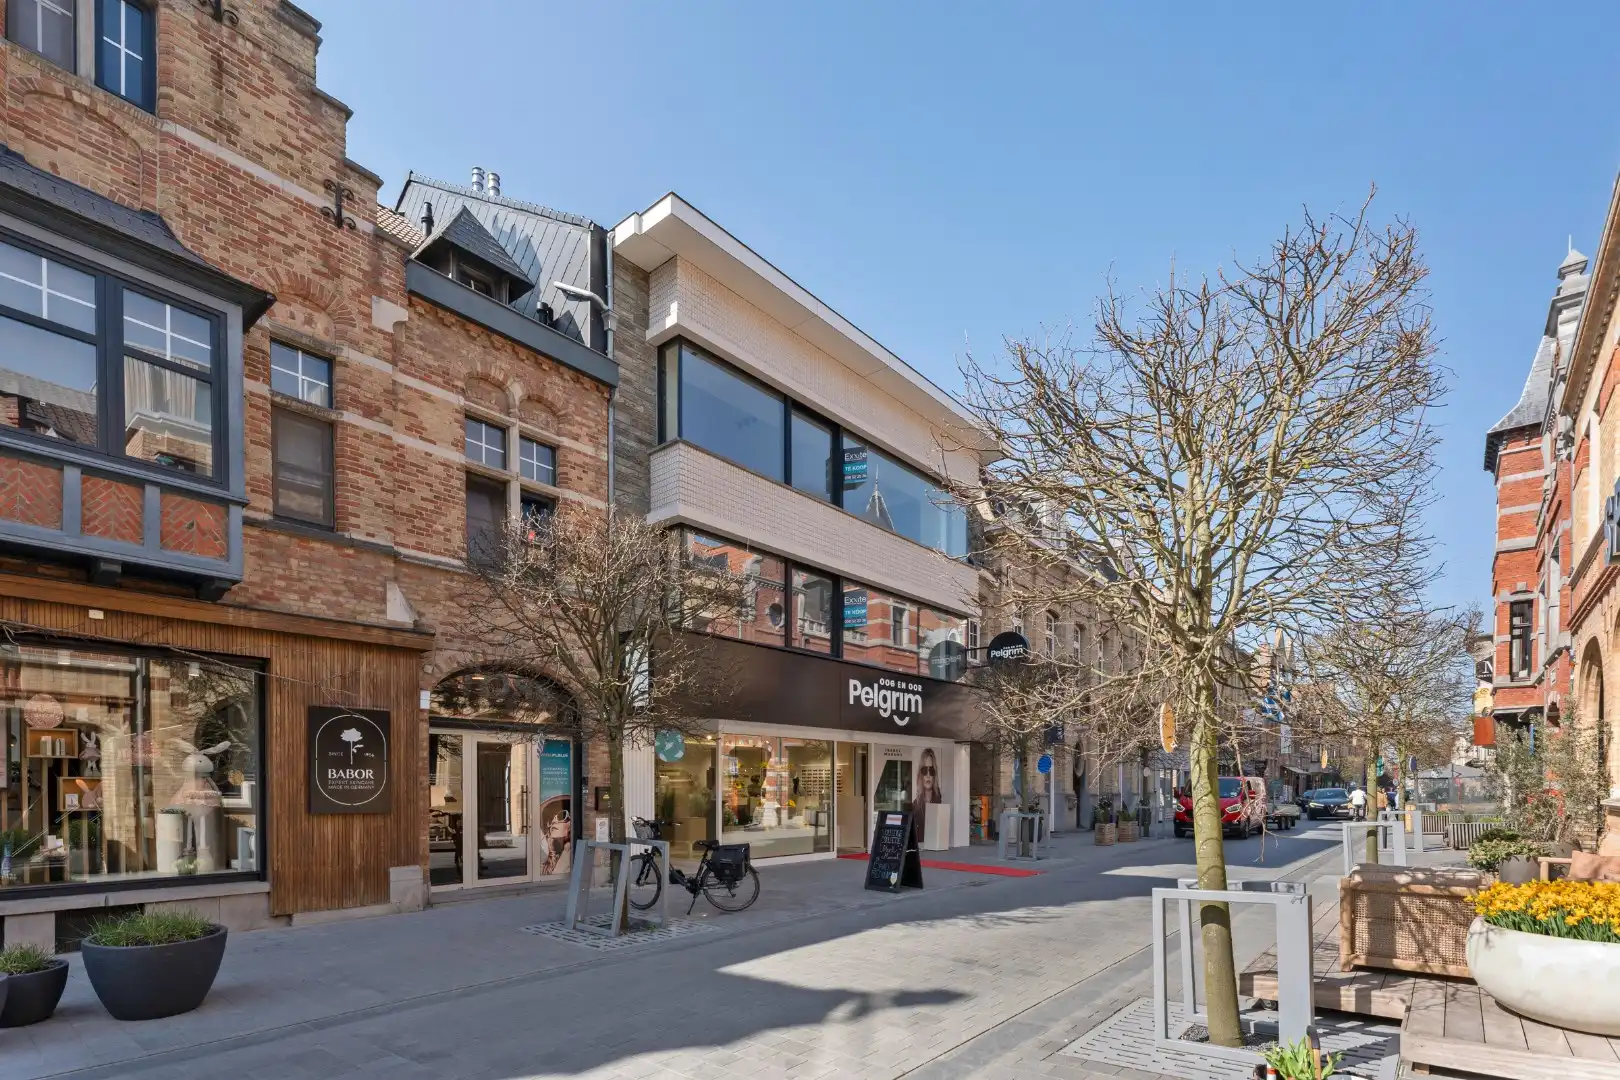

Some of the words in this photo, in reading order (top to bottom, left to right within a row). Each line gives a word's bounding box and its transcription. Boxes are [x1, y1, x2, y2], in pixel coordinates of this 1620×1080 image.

[991, 647, 1024, 658] Pelgrim
[898, 681, 906, 690] EN
[908, 683, 922, 692] OOR
[849, 678, 922, 718] Pelgrim
[328, 768, 374, 780] BABOR
